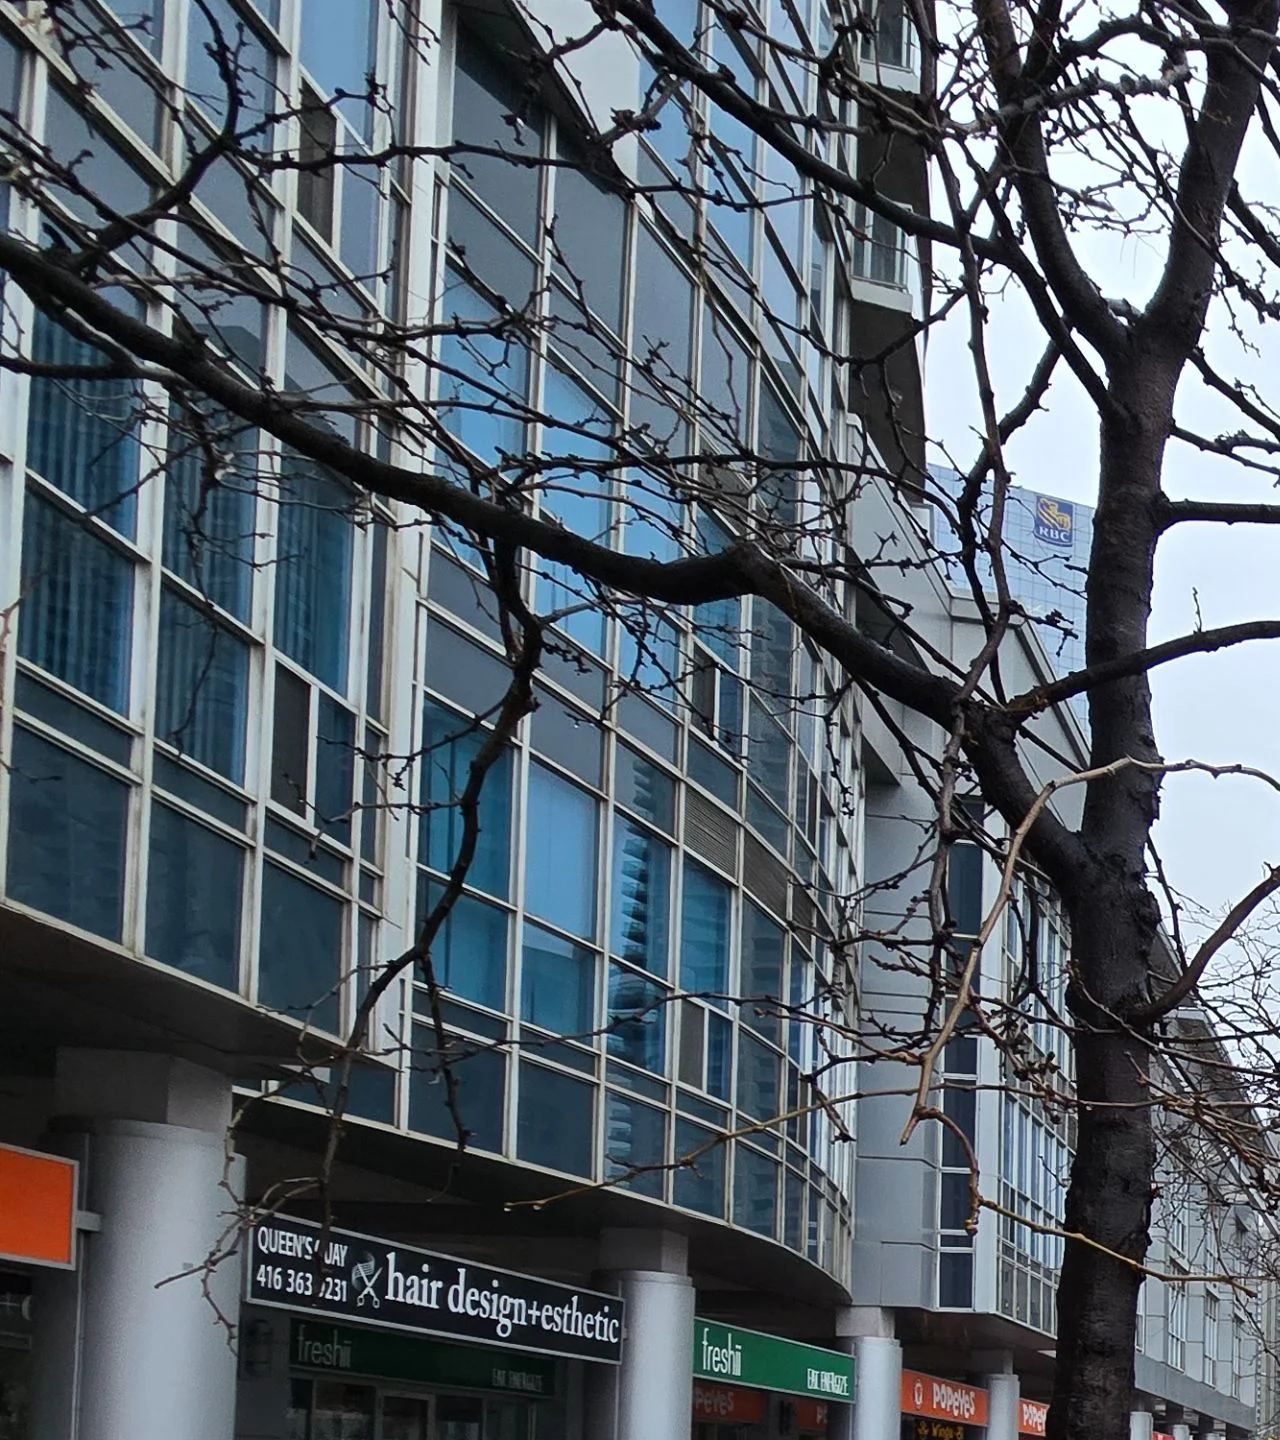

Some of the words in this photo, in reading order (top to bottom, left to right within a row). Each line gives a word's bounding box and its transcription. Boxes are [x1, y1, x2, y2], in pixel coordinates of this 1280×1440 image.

[1039, 526, 1070, 542] RBC
[257, 1225, 314, 1261] QUEEN'S
[314, 1239, 349, 1268] UAY
[256, 1264, 283, 1291] 416
[286, 1269, 313, 1297] 363
[385, 1251, 443, 1309] hair
[296, 1323, 352, 1369] freshii
[702, 1327, 743, 1377] freshii
